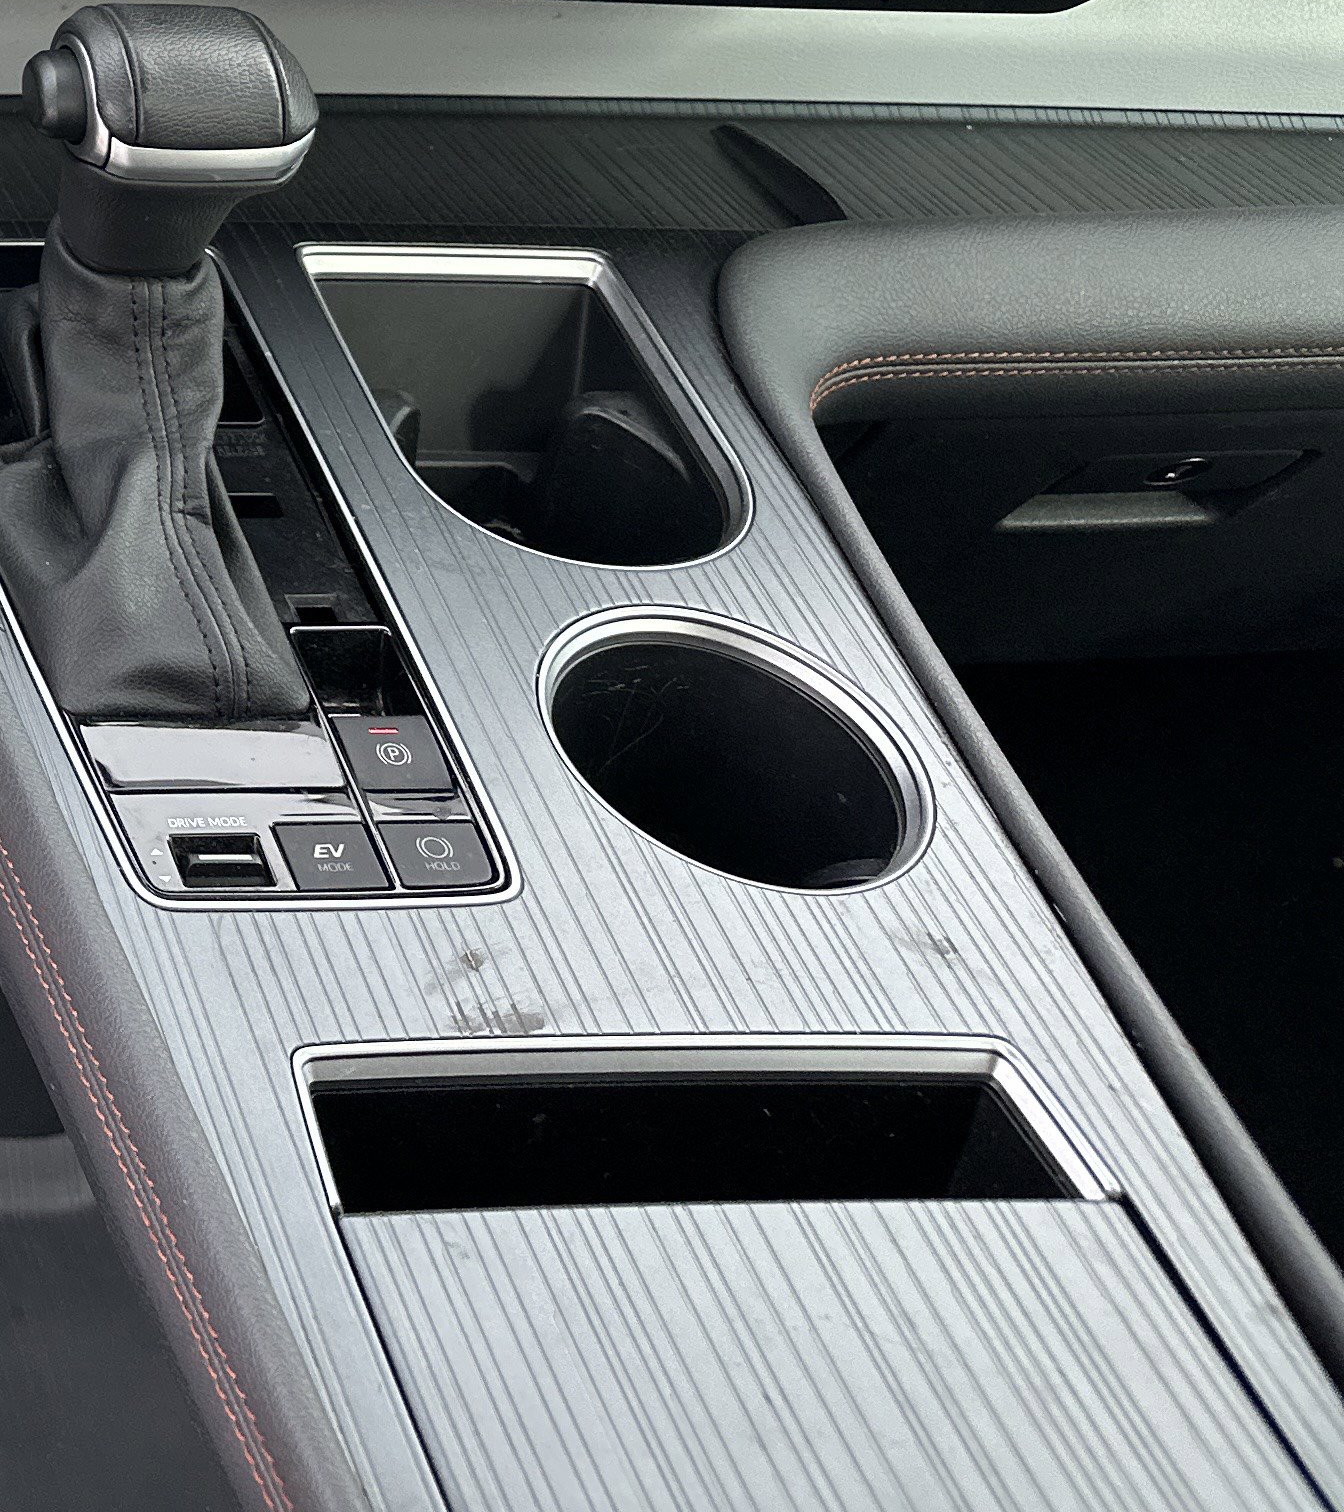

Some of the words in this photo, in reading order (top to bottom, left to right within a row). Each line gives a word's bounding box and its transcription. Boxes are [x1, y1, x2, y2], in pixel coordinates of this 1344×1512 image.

[167, 817, 205, 828] DRIVE
[208, 817, 248, 828] MODE
[313, 844, 345, 859] EV
[317, 862, 355, 872] MODE
[425, 861, 461, 871] HOLD
